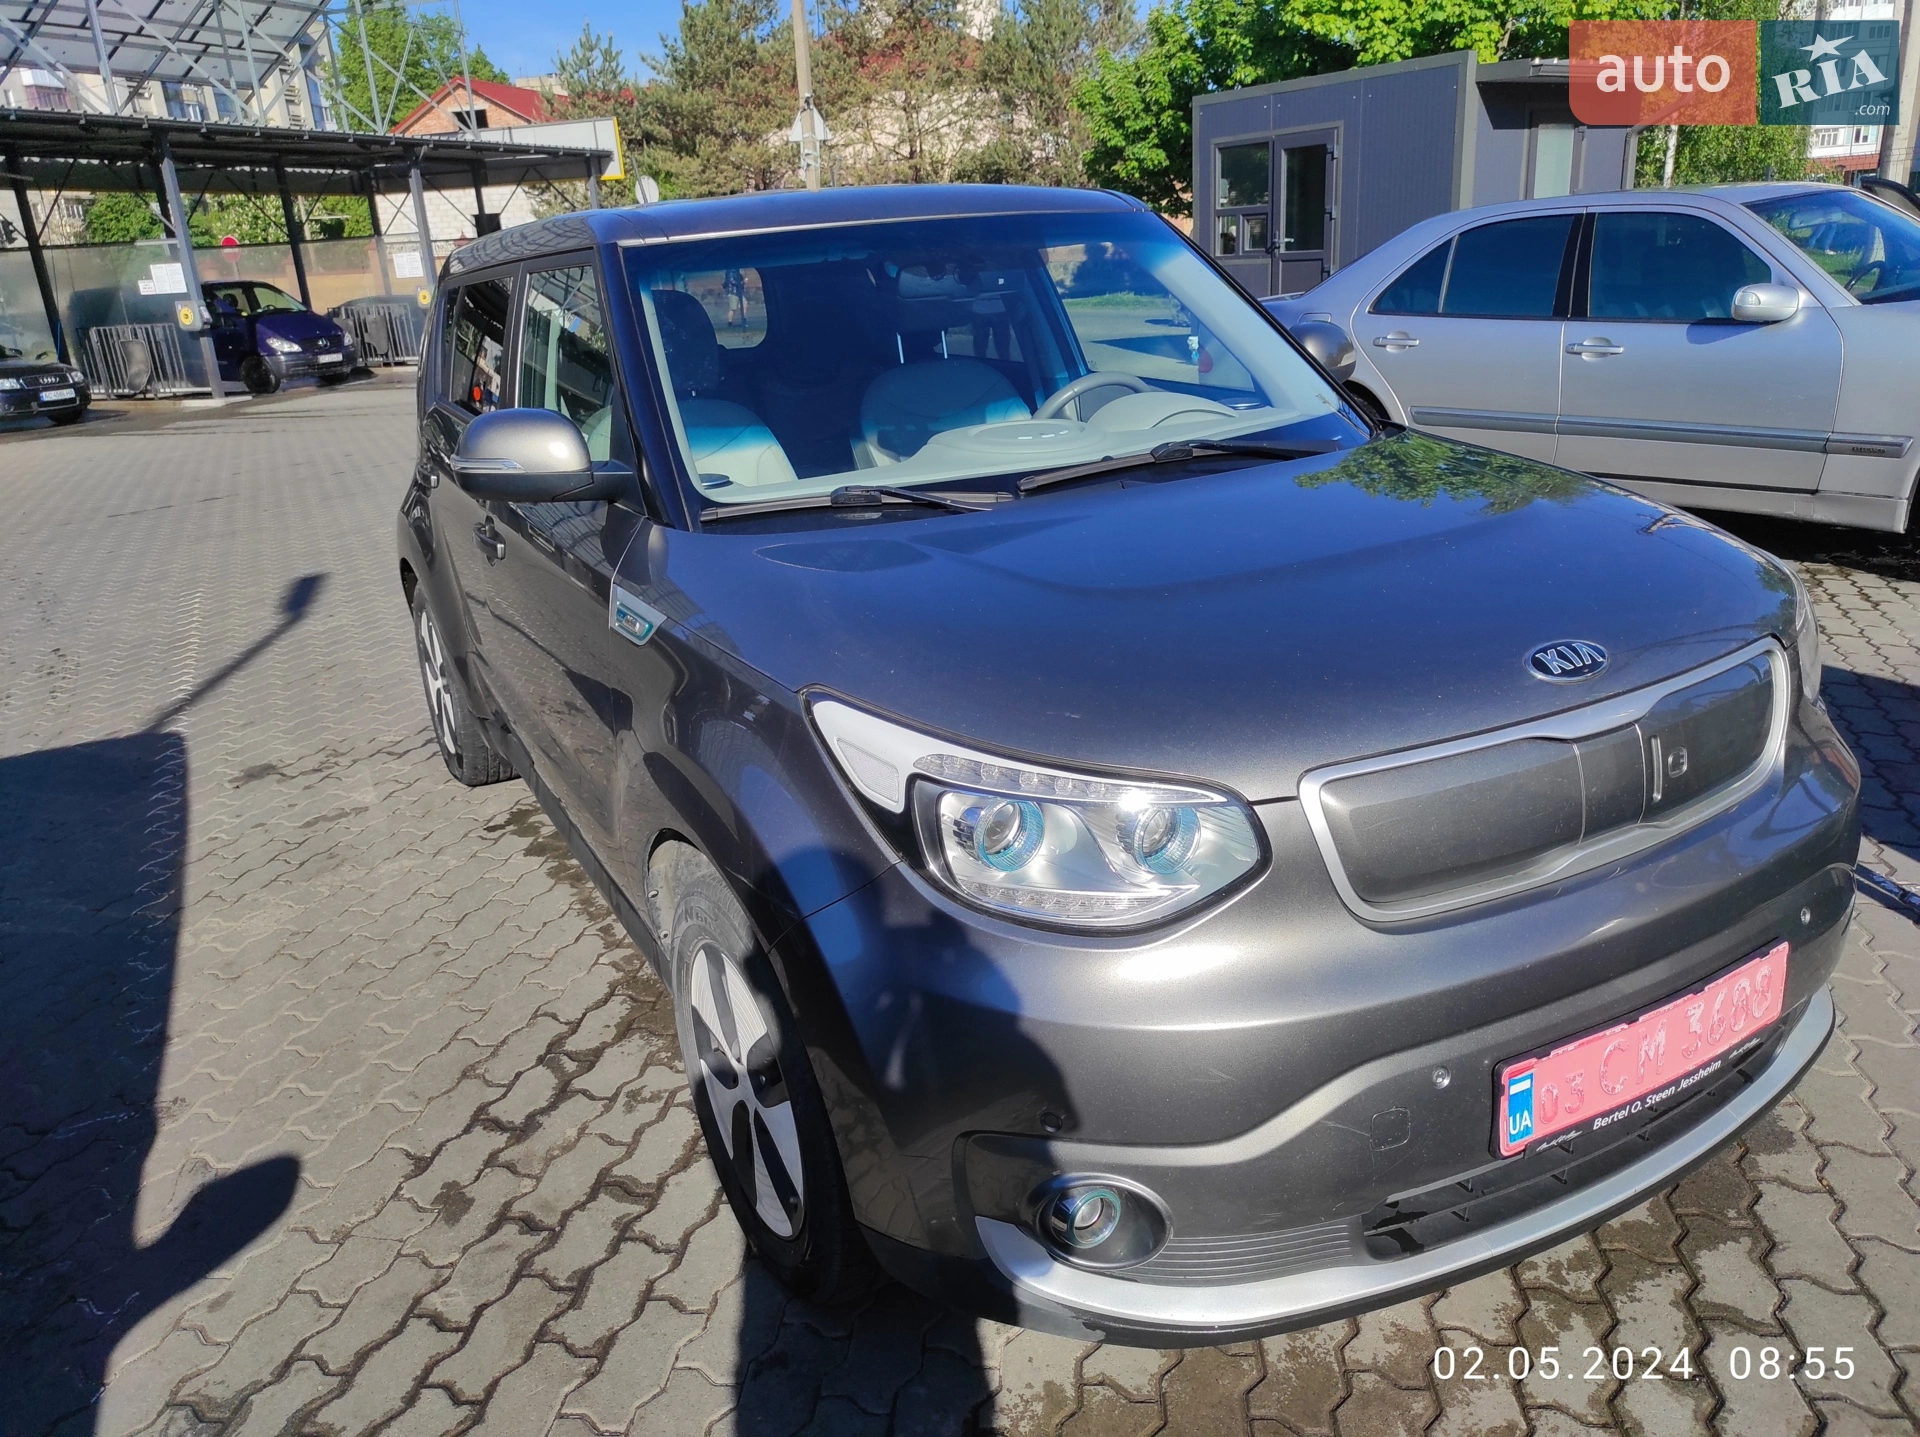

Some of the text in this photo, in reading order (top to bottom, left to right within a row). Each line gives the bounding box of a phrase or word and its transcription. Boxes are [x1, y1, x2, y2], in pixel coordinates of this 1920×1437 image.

[1535, 642, 1604, 674] KIA
[1540, 1072, 1585, 1125] 03
[1600, 1018, 1667, 1096] CM
[1592, 1059, 1722, 1131] Bertel O. Steen Jessheim
[1508, 1110, 1533, 1135] UA
